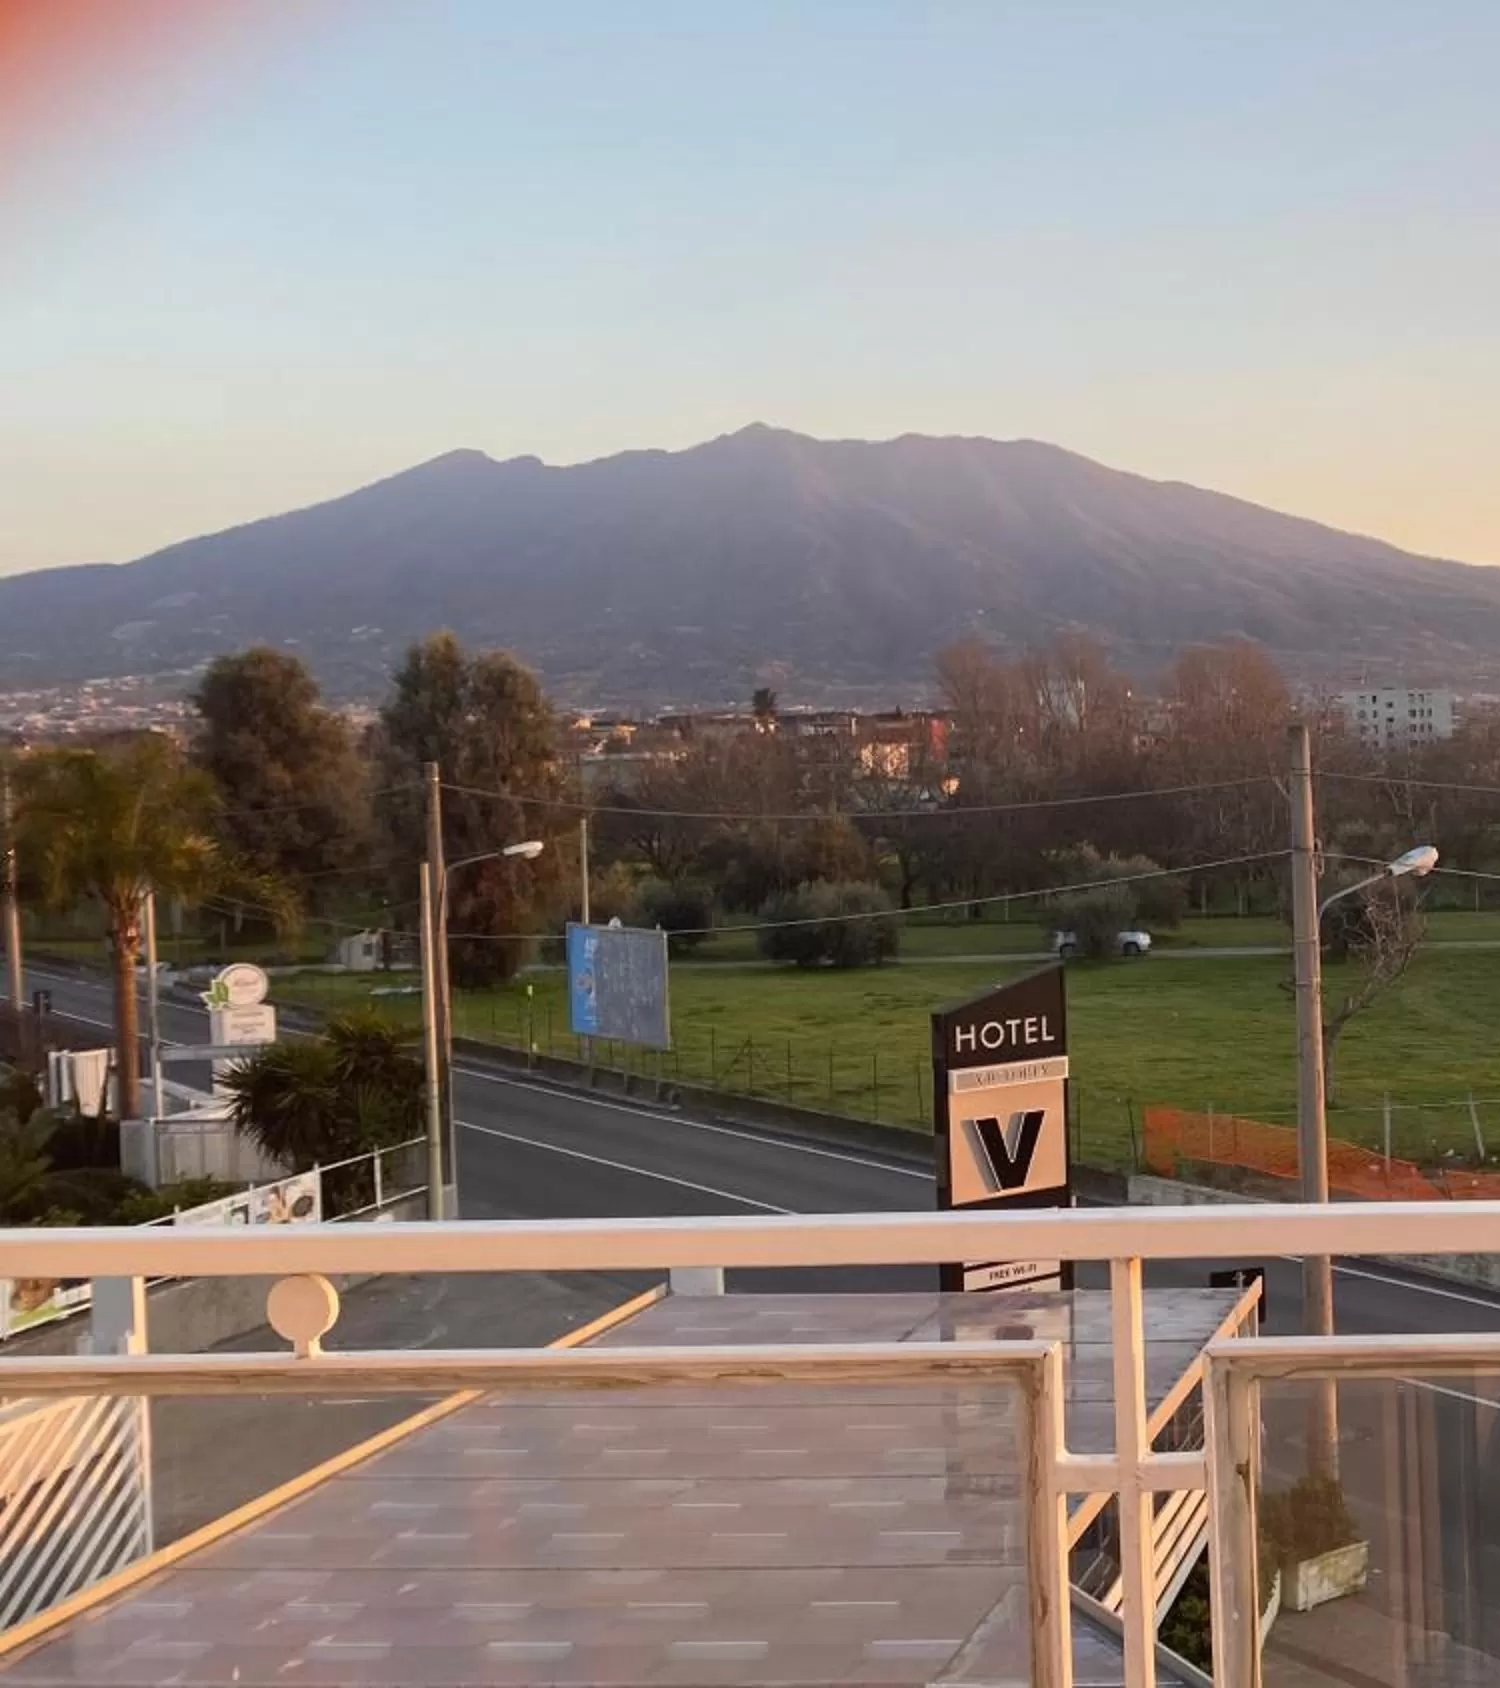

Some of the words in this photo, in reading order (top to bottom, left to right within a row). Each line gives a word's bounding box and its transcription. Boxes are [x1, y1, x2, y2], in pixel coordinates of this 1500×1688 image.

[955, 1016, 1055, 1052] HOTEL
[961, 1109, 1046, 1193] V
[989, 1267, 1009, 1281] FREE
